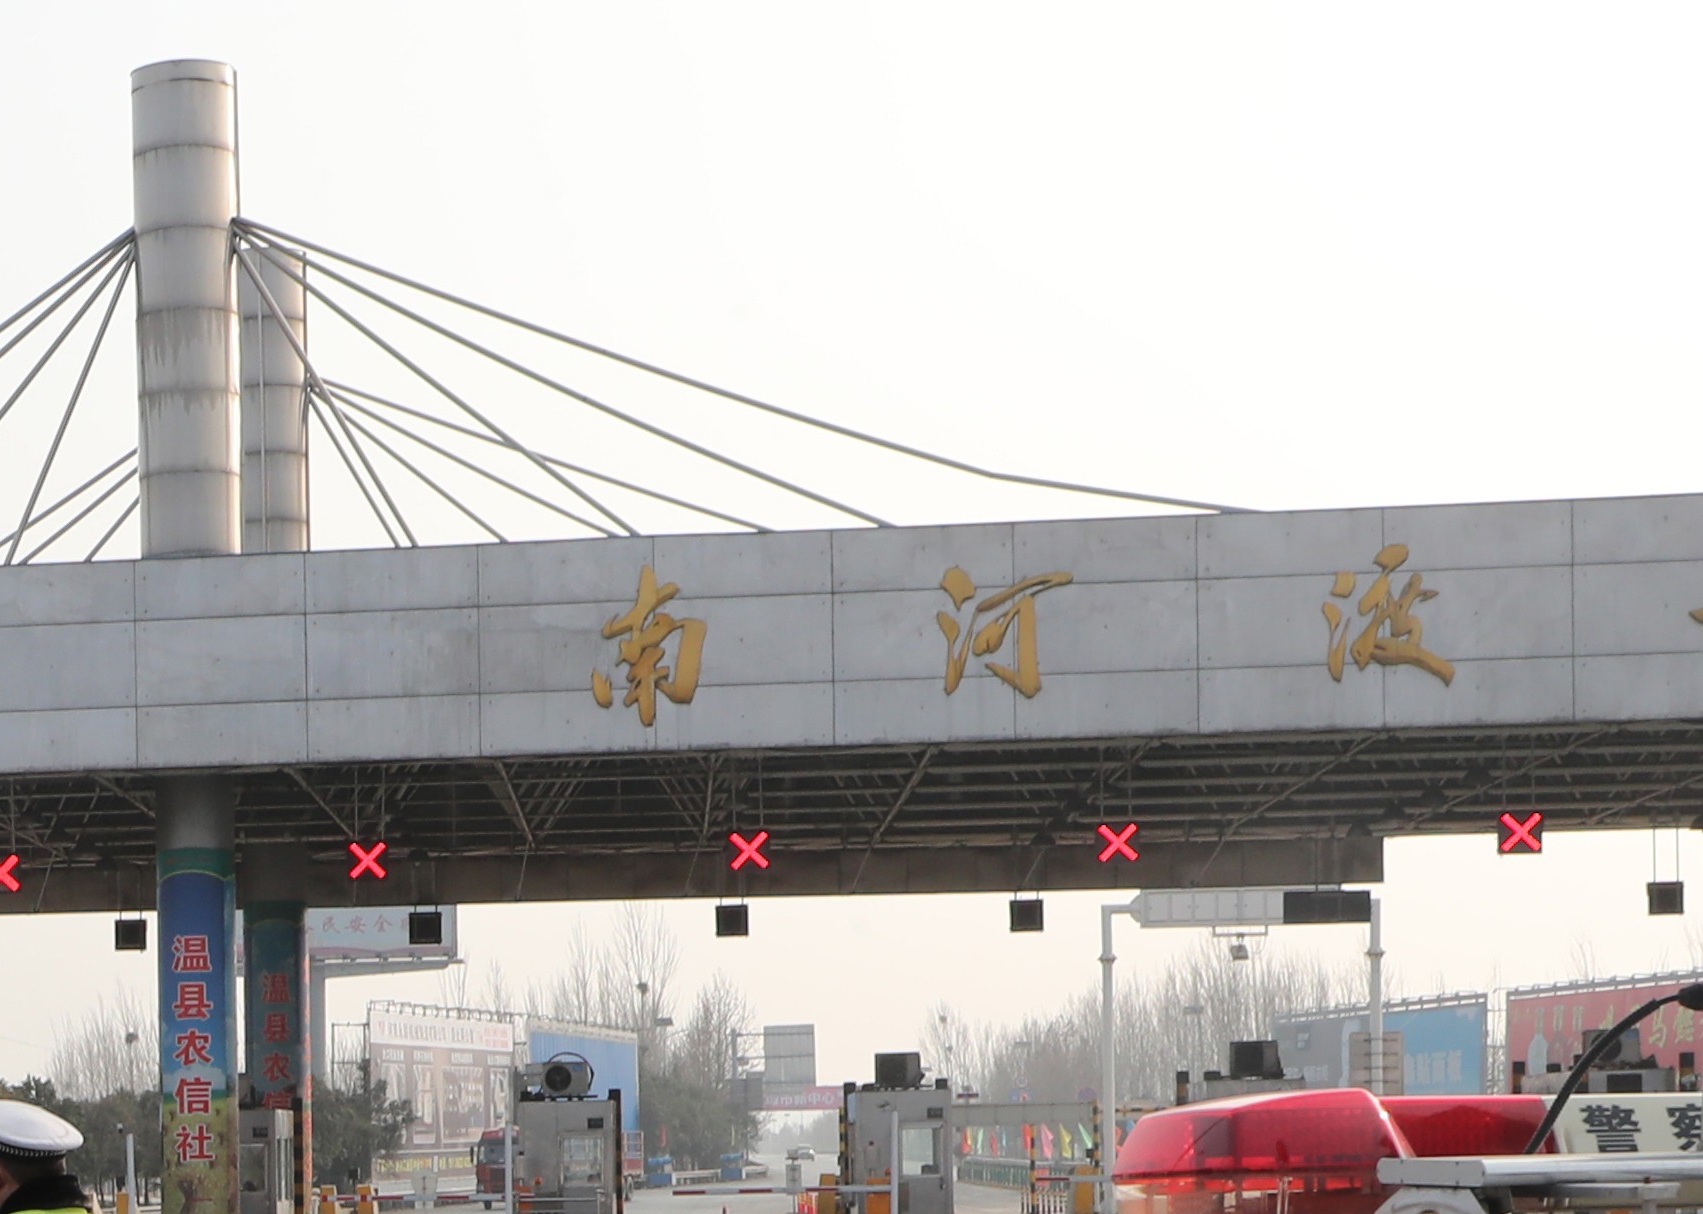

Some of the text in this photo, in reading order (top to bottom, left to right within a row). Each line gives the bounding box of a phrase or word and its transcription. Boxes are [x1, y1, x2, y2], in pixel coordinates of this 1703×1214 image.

[591, 543, 1703, 728] 南河渡
[306, 914, 410, 934] 民安全
[171, 934, 216, 1163] 温县农信社
[1580, 1103, 1702, 1152] 警察
